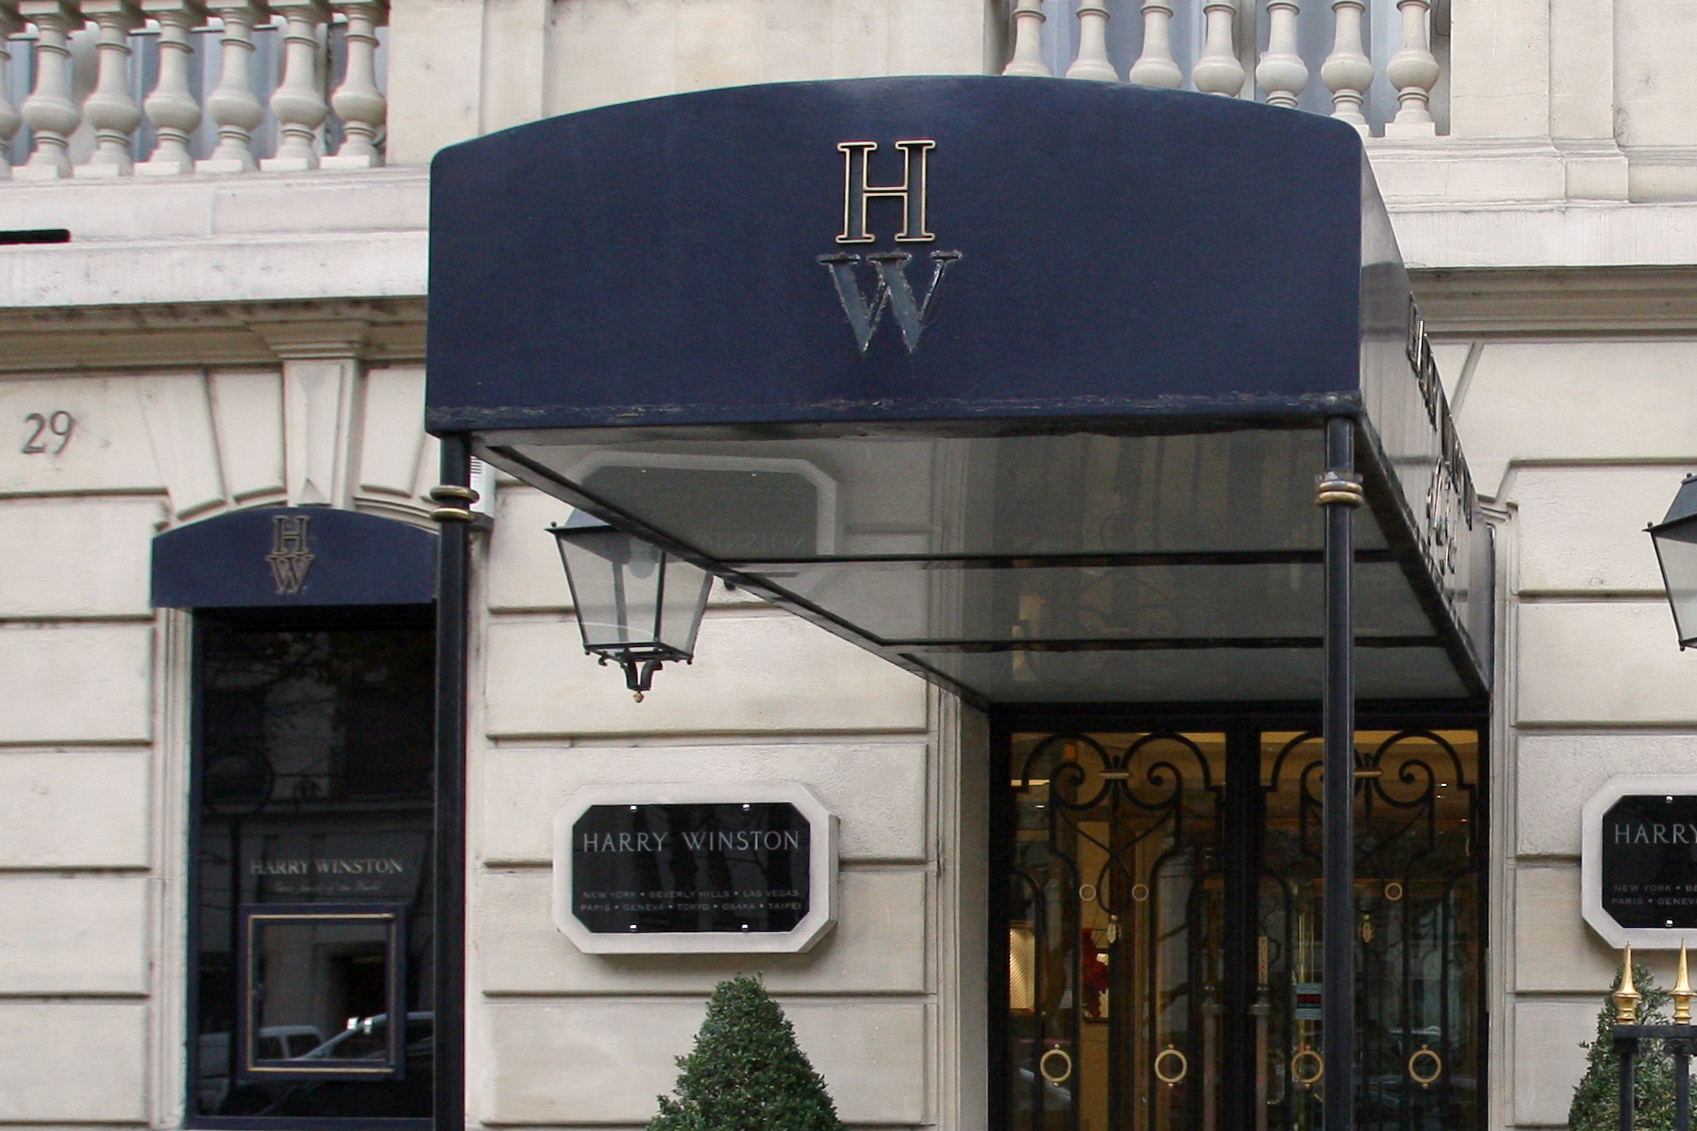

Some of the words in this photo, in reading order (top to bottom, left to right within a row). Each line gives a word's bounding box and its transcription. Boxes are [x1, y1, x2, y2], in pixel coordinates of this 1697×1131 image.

[835, 138, 937, 244] H
[817, 249, 963, 354] W
[21, 410, 76, 456] 29
[272, 515, 311, 556] H
[266, 553, 314, 595] W
[583, 831, 668, 852] HARRY
[681, 830, 799, 850] WINSTON
[251, 859, 309, 874] HARRY
[314, 859, 403, 874] WINSTON
[700, 890, 730, 898] HILLS
[743, 890, 763, 898] LAS
[1613, 884, 1639, 892] NEW
[1644, 884, 1671, 892] YORK
[677, 903, 710, 911] TOKYO
[1611, 897, 1643, 905] PARIS
